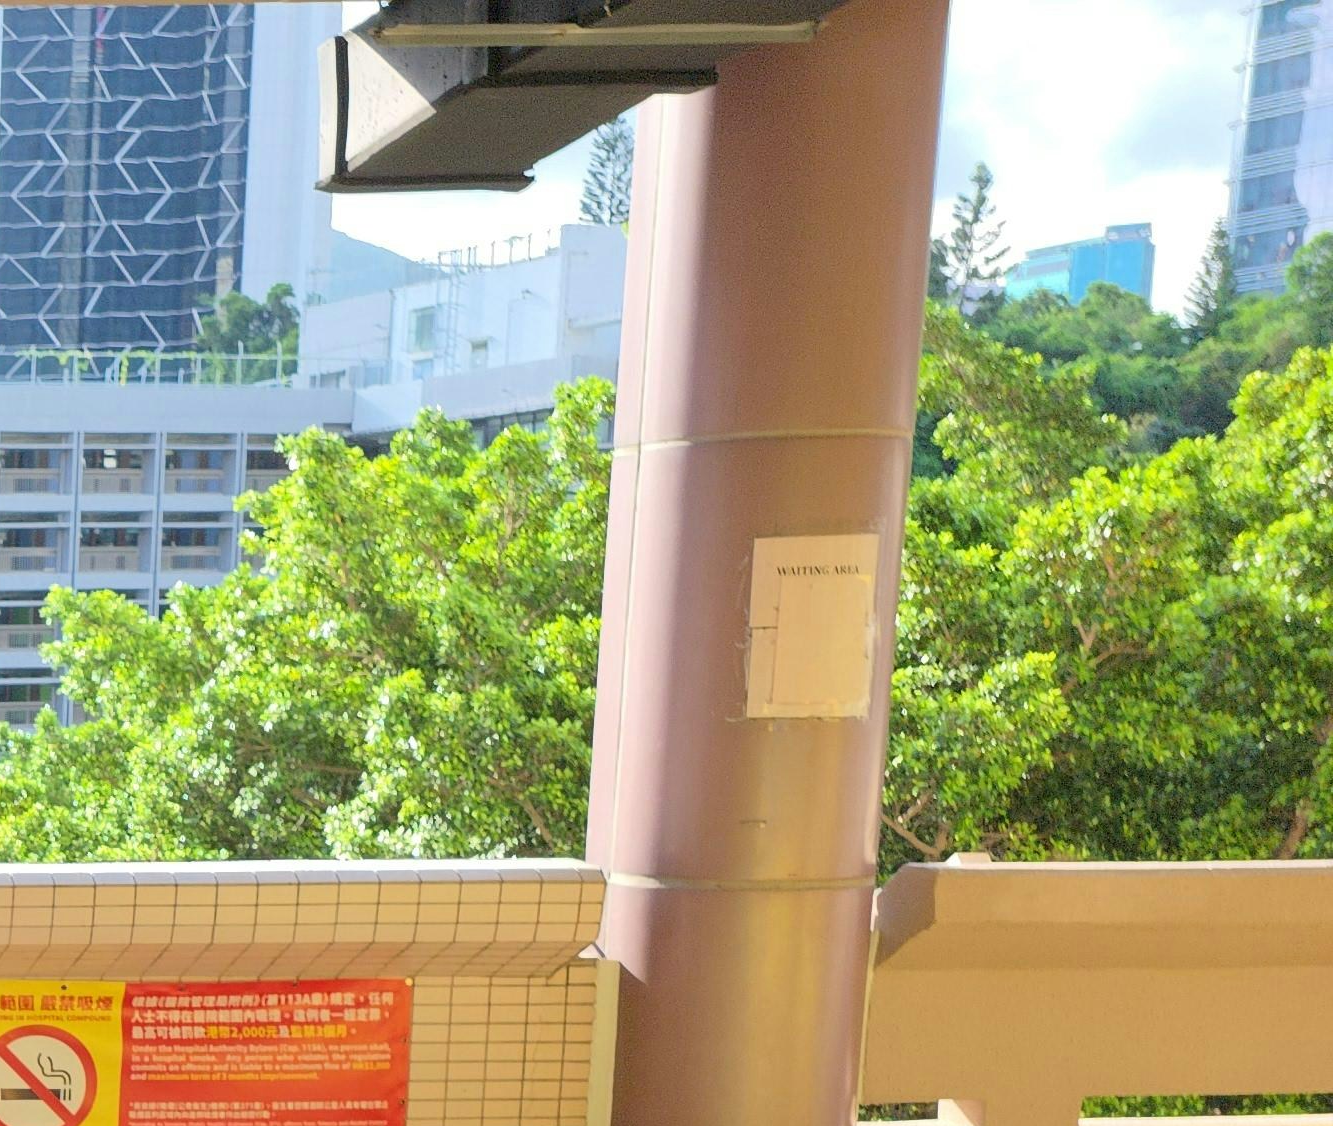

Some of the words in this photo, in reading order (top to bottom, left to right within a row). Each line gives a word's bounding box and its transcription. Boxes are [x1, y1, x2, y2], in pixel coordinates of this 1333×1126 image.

[776, 564, 830, 576] WAITING
[834, 564, 860, 575] AREA
[41, 995, 113, 1011] 嚴禁吸煙
